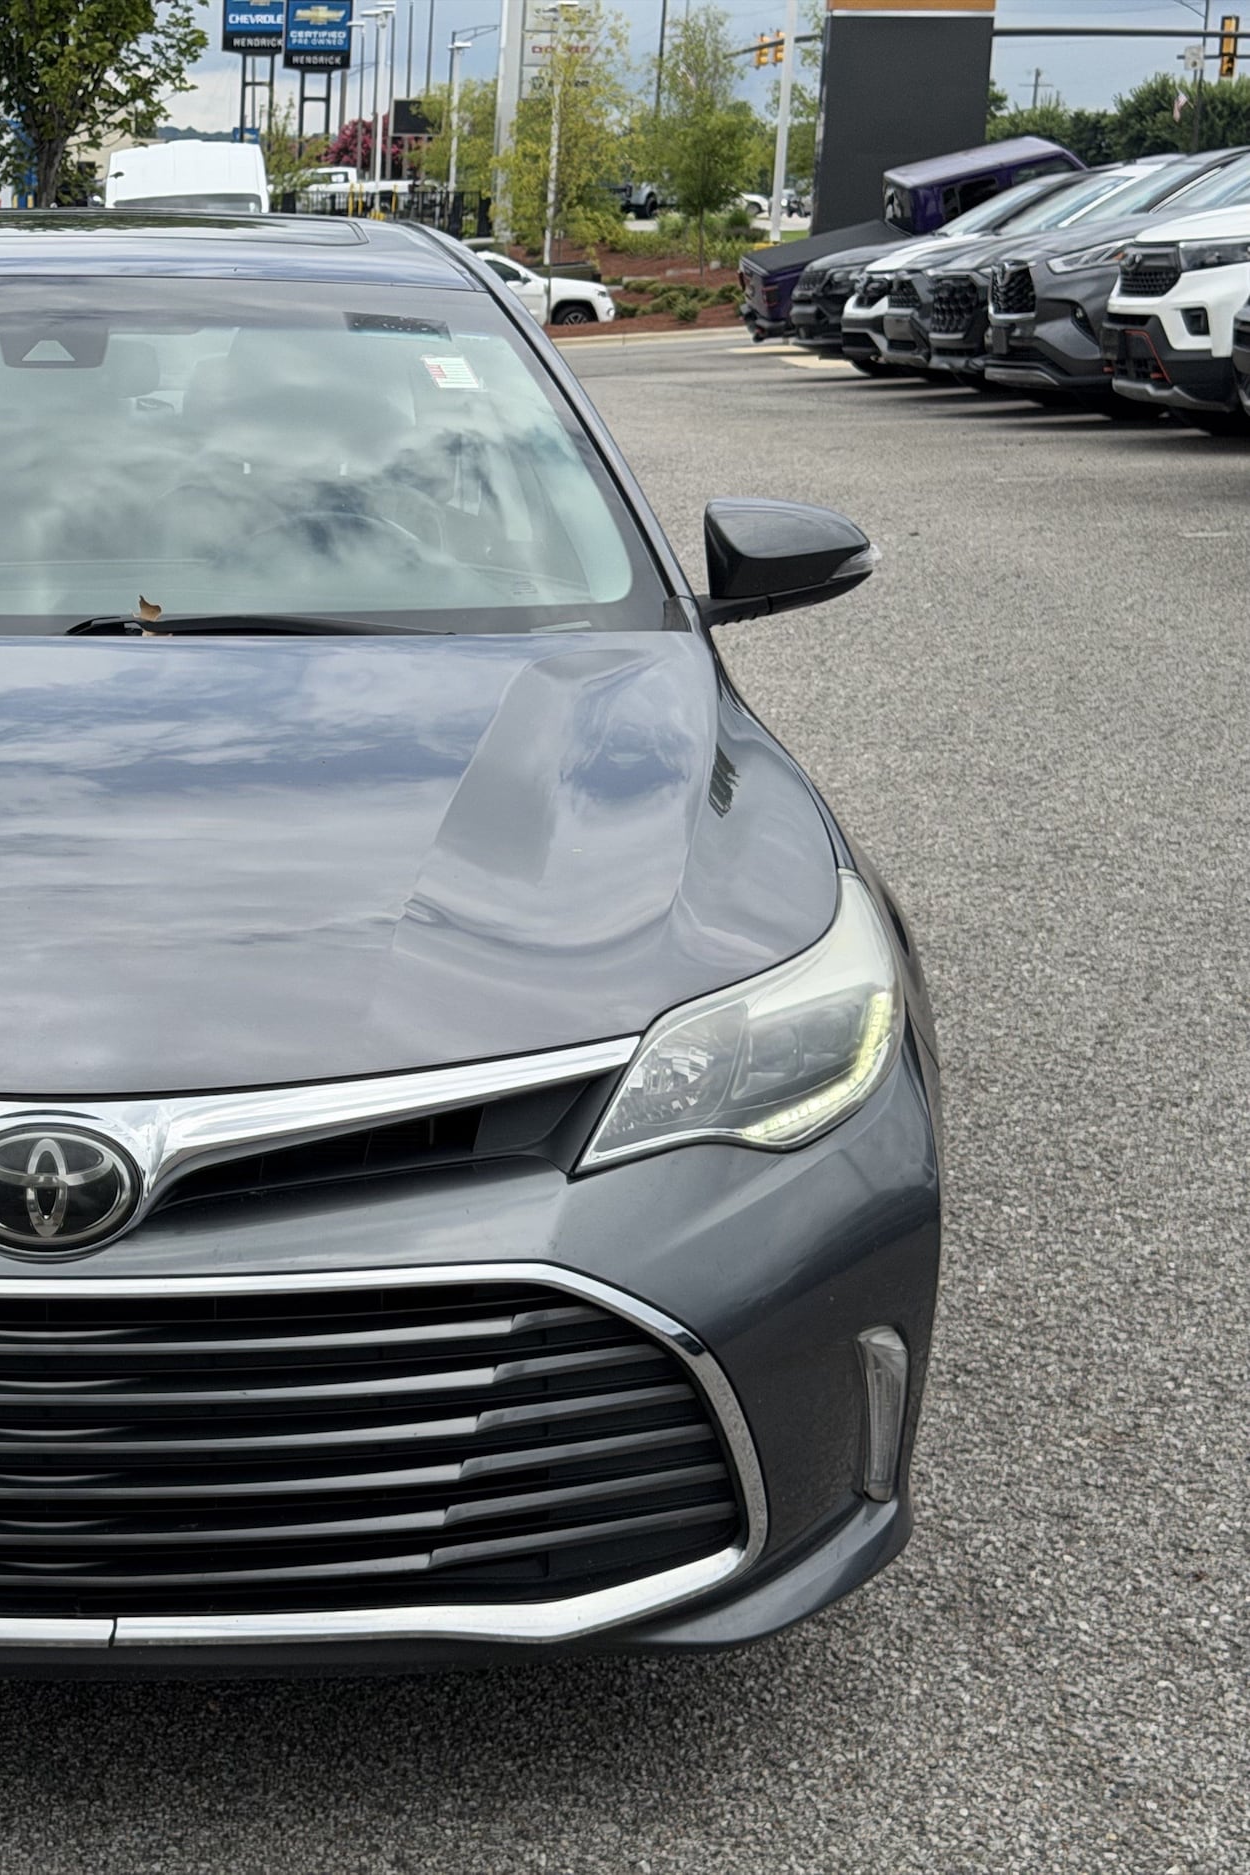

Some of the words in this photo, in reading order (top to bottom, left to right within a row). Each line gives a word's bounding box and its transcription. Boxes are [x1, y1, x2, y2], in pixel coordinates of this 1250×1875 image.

[228, 13, 283, 25] CHEVROLE
[290, 30, 346, 39] CERTIFIED
[232, 36, 283, 48] HENDRICK
[292, 55, 341, 66] HENDRICK
